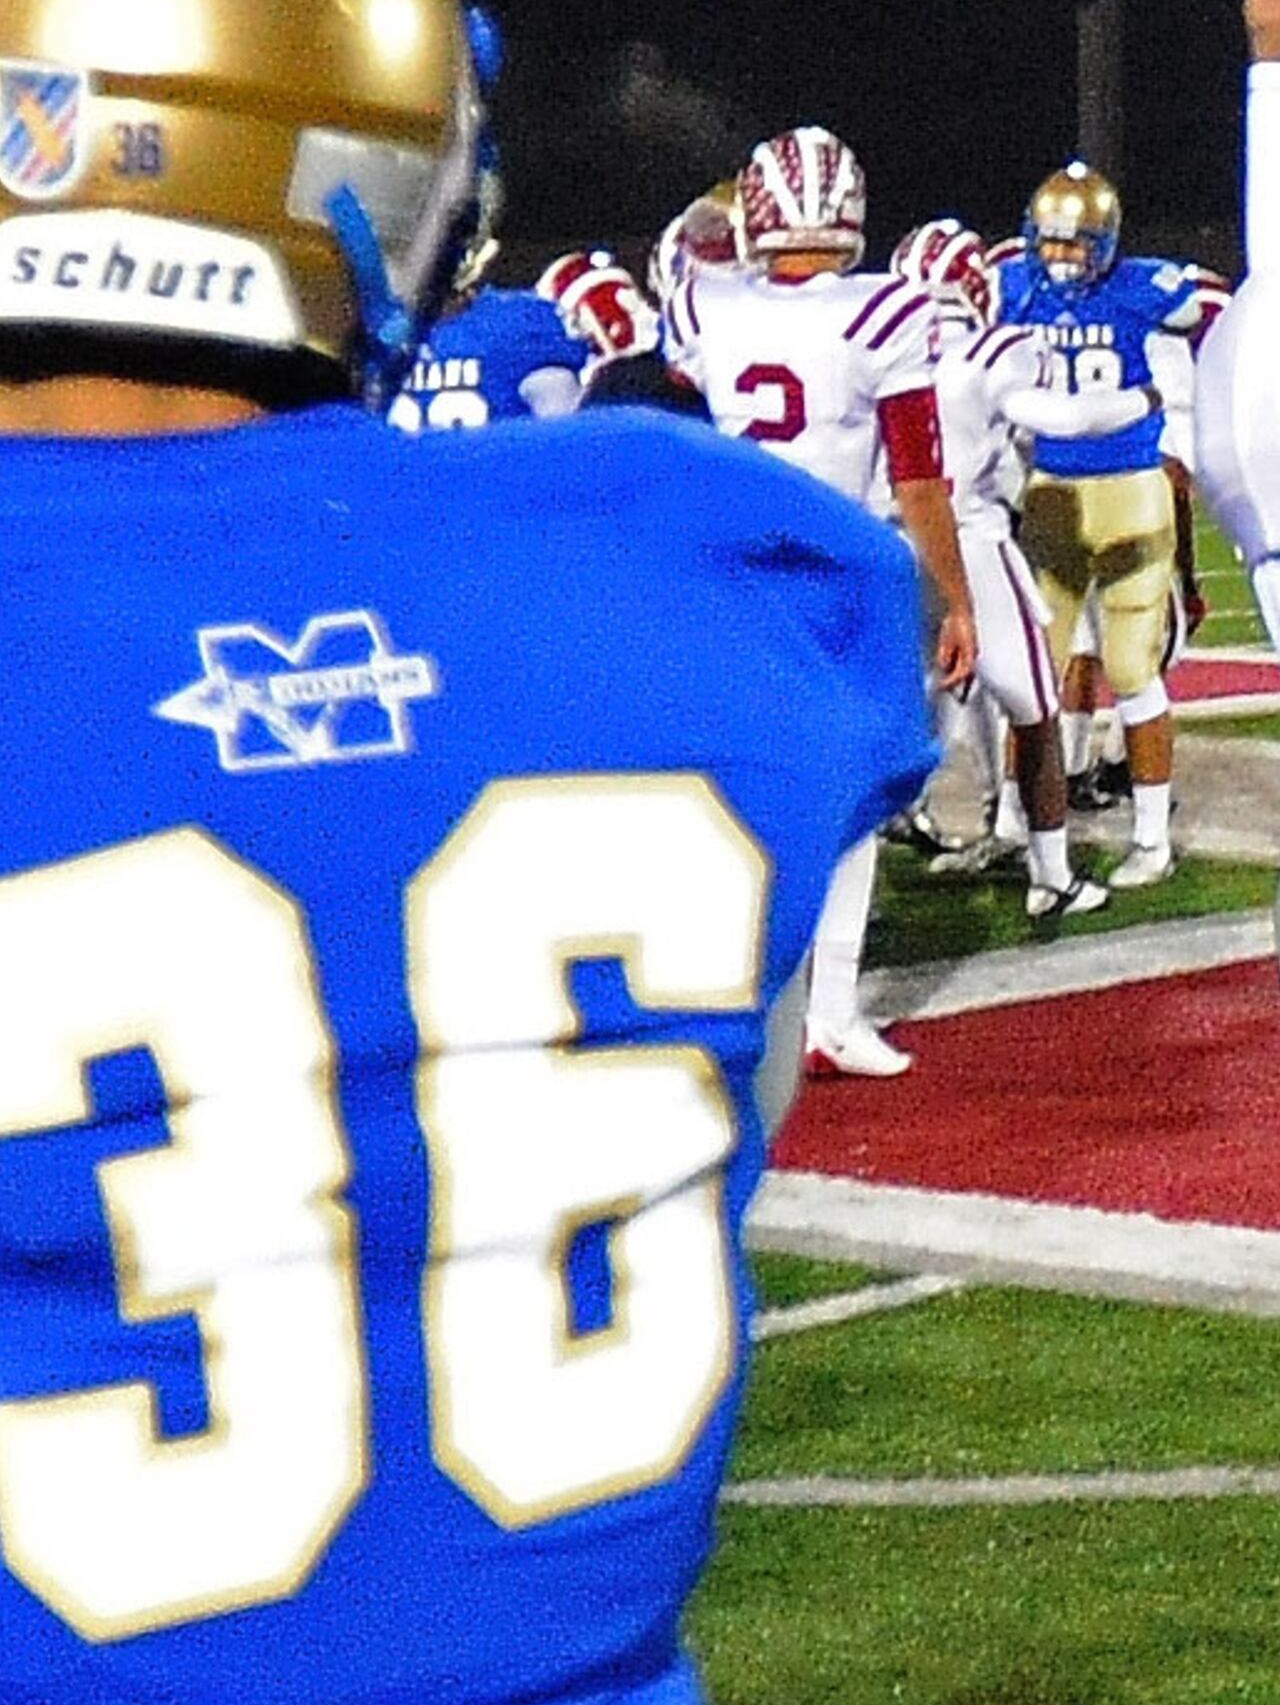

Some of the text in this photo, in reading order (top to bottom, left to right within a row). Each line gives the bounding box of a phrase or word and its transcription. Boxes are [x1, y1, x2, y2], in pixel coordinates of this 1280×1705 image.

[110, 122, 162, 178] 36
[10, 240, 257, 305] schutt
[735, 363, 807, 442] 2
